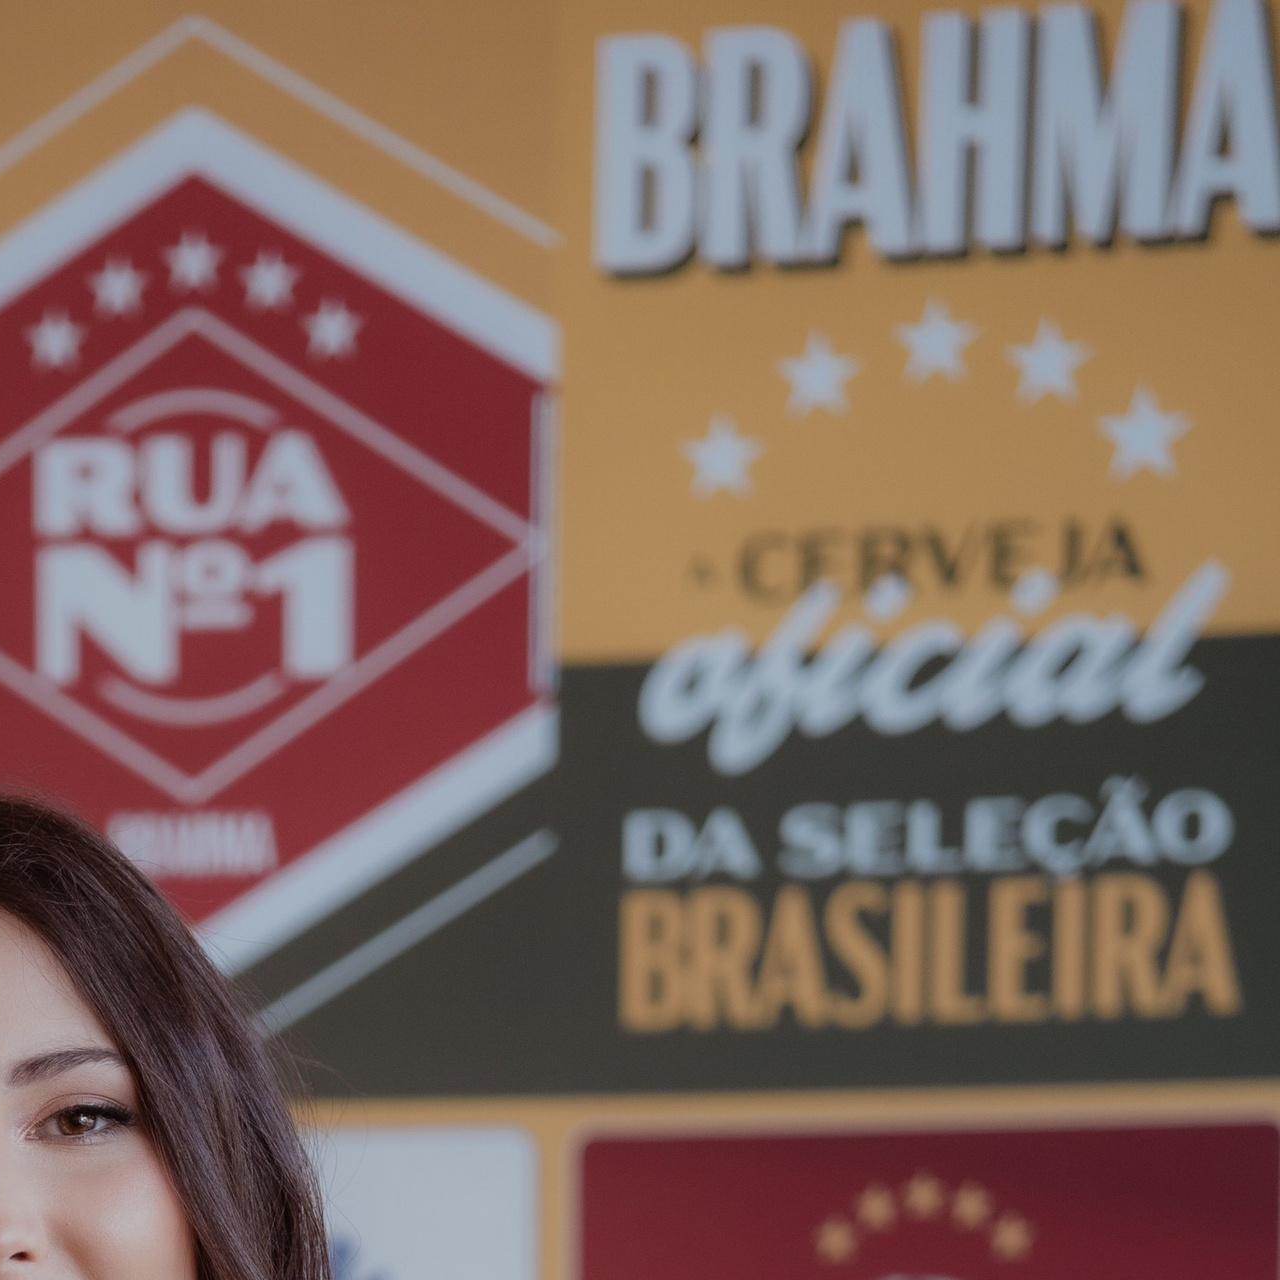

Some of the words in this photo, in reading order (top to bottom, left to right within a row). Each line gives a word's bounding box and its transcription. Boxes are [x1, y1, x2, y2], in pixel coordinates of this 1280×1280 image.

[592, 0, 1280, 274] BRAHMA
[33, 428, 350, 540] RUA
[730, 512, 1150, 606] CERVEJA
[638, 558, 1232, 778] oficial
[620, 806, 762, 884] DA
[777, 774, 1236, 884] SELEÇÃO
[618, 868, 1242, 1034] BRASILEIRA
